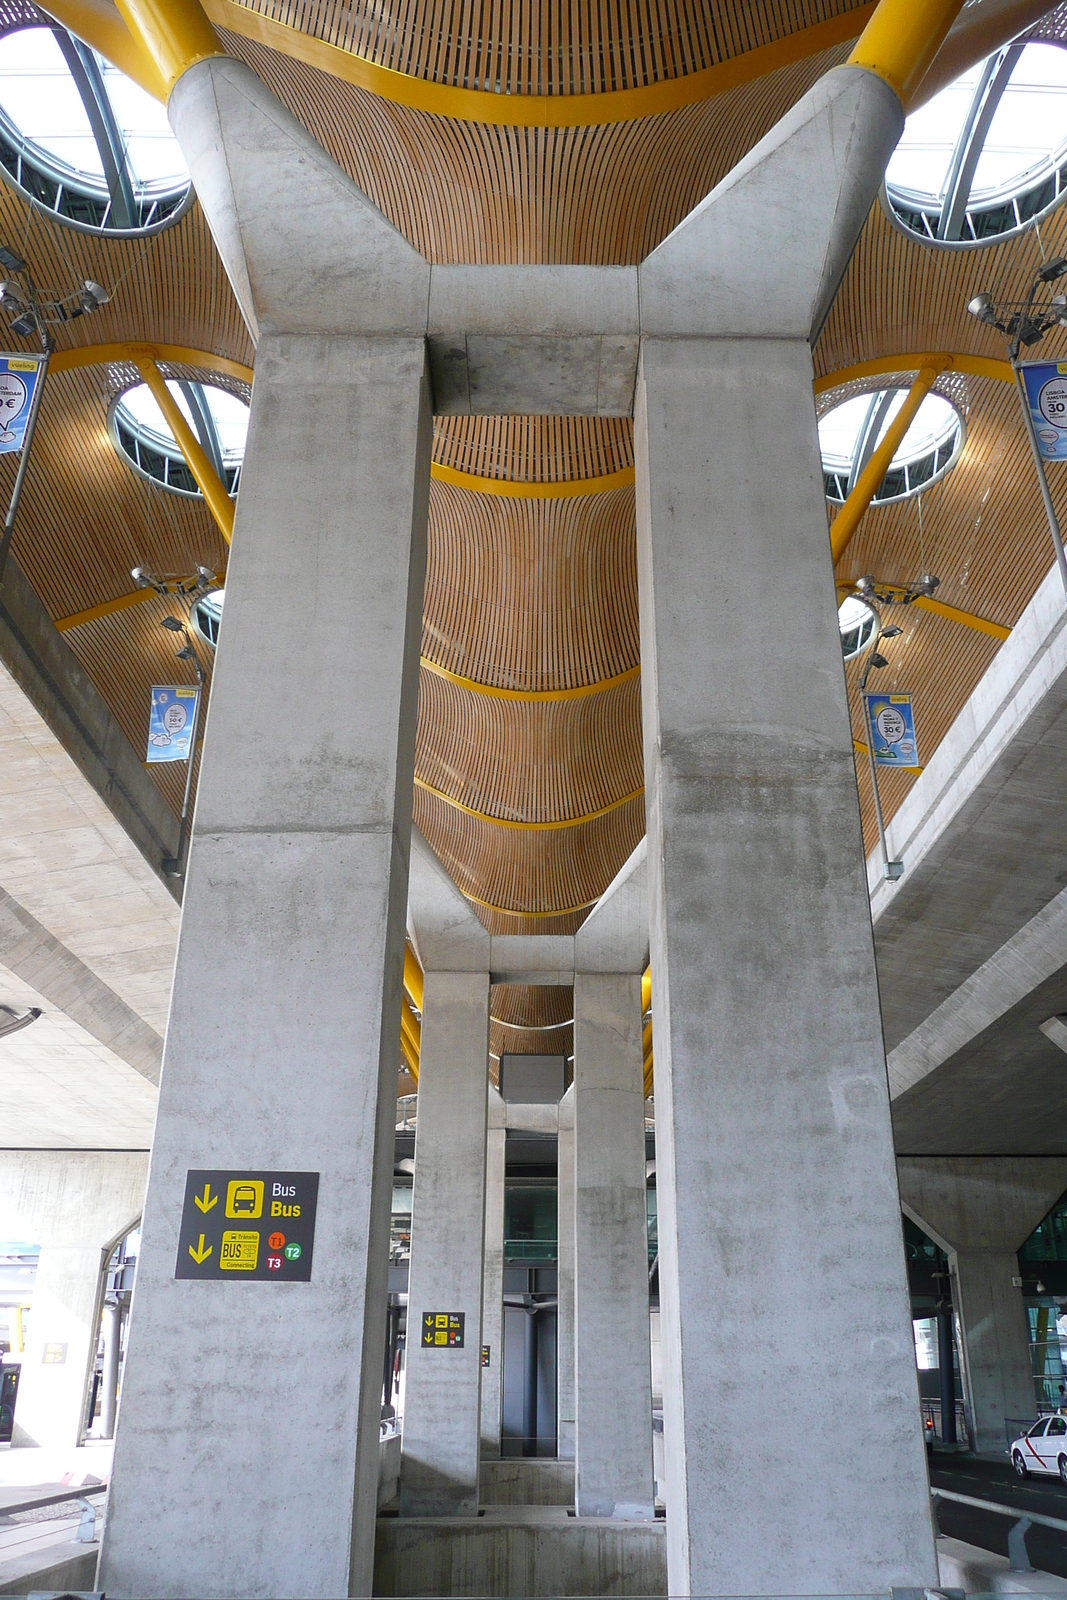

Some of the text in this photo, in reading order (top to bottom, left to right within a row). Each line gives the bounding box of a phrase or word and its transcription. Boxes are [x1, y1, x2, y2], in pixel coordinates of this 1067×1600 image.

[12, 362, 34, 370] vueling
[1048, 403, 1065, 413] 30
[272, 1182, 296, 1197] Bus
[270, 1201, 301, 1217] Bus
[271, 1238, 282, 1246] T1
[222, 1243, 242, 1258] BUS
[286, 1248, 300, 1258] T2
[268, 1258, 281, 1268] T3
